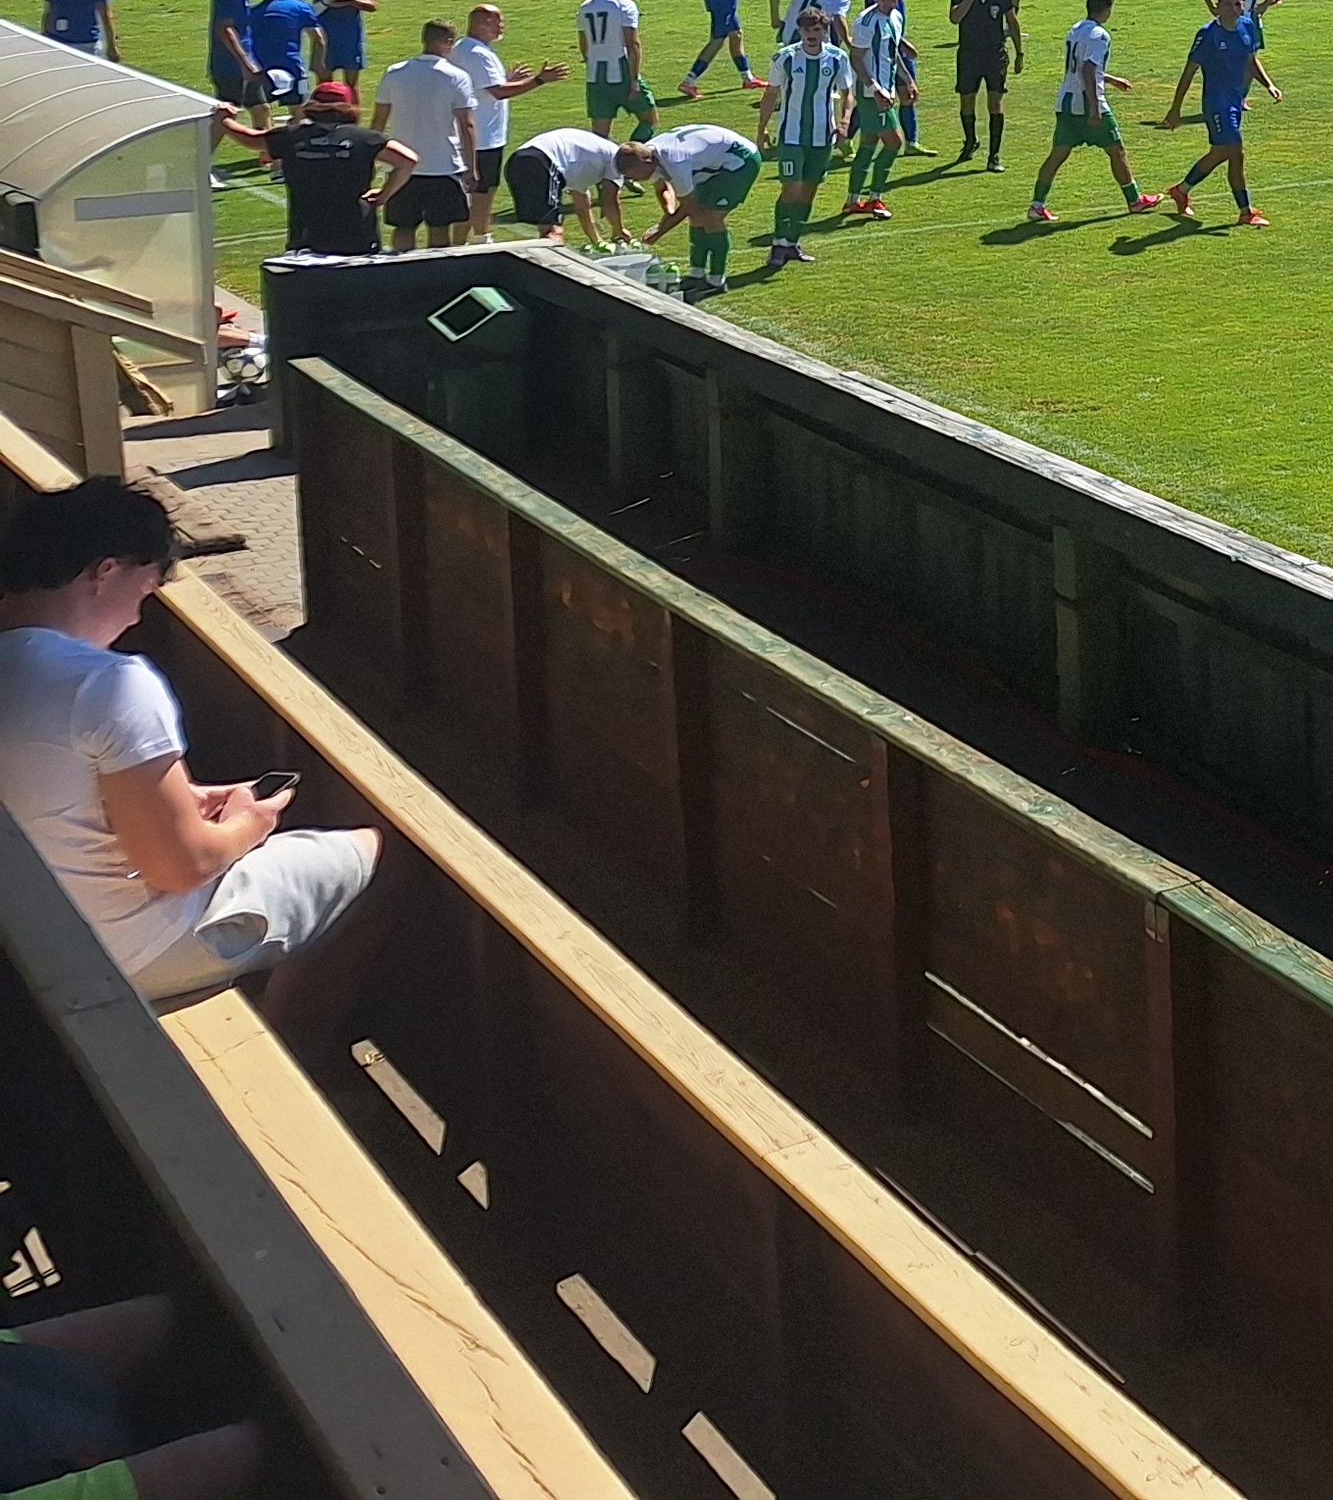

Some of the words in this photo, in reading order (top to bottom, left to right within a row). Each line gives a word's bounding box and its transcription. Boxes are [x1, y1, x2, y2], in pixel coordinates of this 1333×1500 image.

[584, 11, 608, 45] 17
[878, 112, 886, 127] 7
[782, 161, 794, 177] 10
